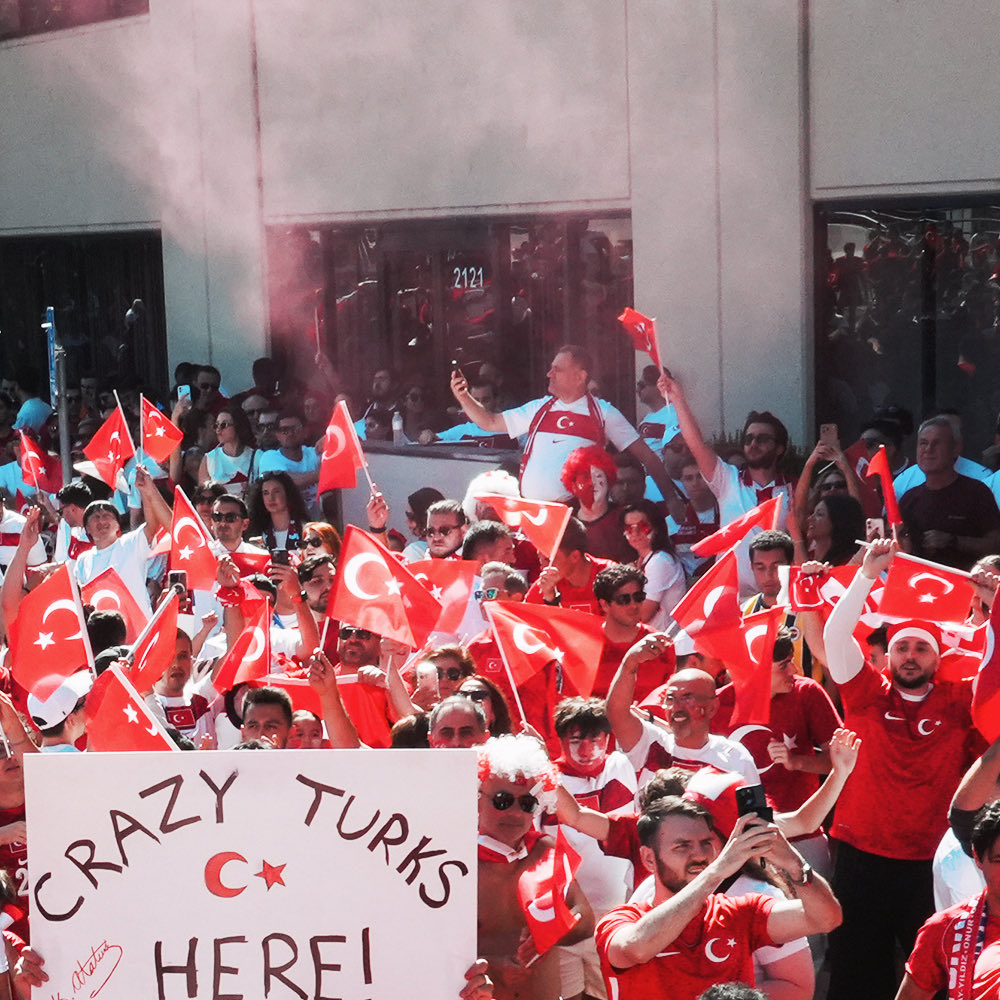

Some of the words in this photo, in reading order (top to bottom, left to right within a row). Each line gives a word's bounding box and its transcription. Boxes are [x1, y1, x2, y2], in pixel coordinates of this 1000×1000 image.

[453, 267, 483, 288] 2121
[34, 768, 239, 921] CRAZY
[296, 774, 469, 908] TURKS
